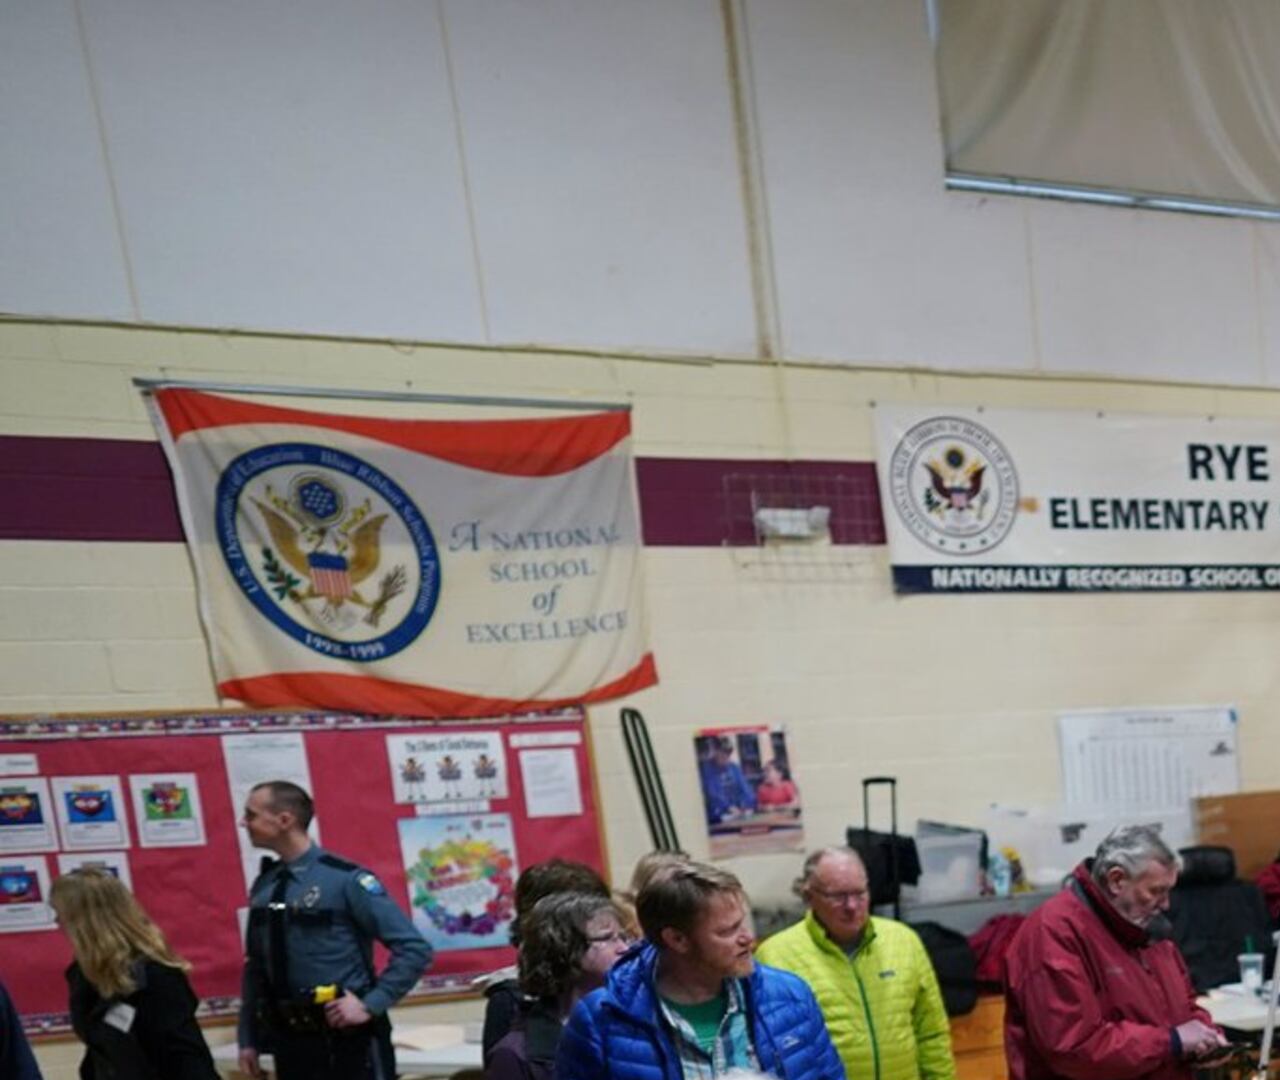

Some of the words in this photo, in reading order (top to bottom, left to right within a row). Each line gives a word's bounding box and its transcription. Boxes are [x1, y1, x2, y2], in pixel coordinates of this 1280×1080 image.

[1187, 443, 1270, 481] RYE
[1050, 498, 1269, 530] ELEMENTARY
[448, 519, 480, 552] A
[489, 523, 622, 551] NATIONAL
[489, 558, 598, 583] SCHOOL
[931, 568, 1061, 588] NATIONALLY
[1065, 568, 1186, 587] RECOGNIZED
[1190, 568, 1262, 586] SCHOOL
[532, 583, 562, 616] of
[466, 610, 628, 645] EXCELLENCE
